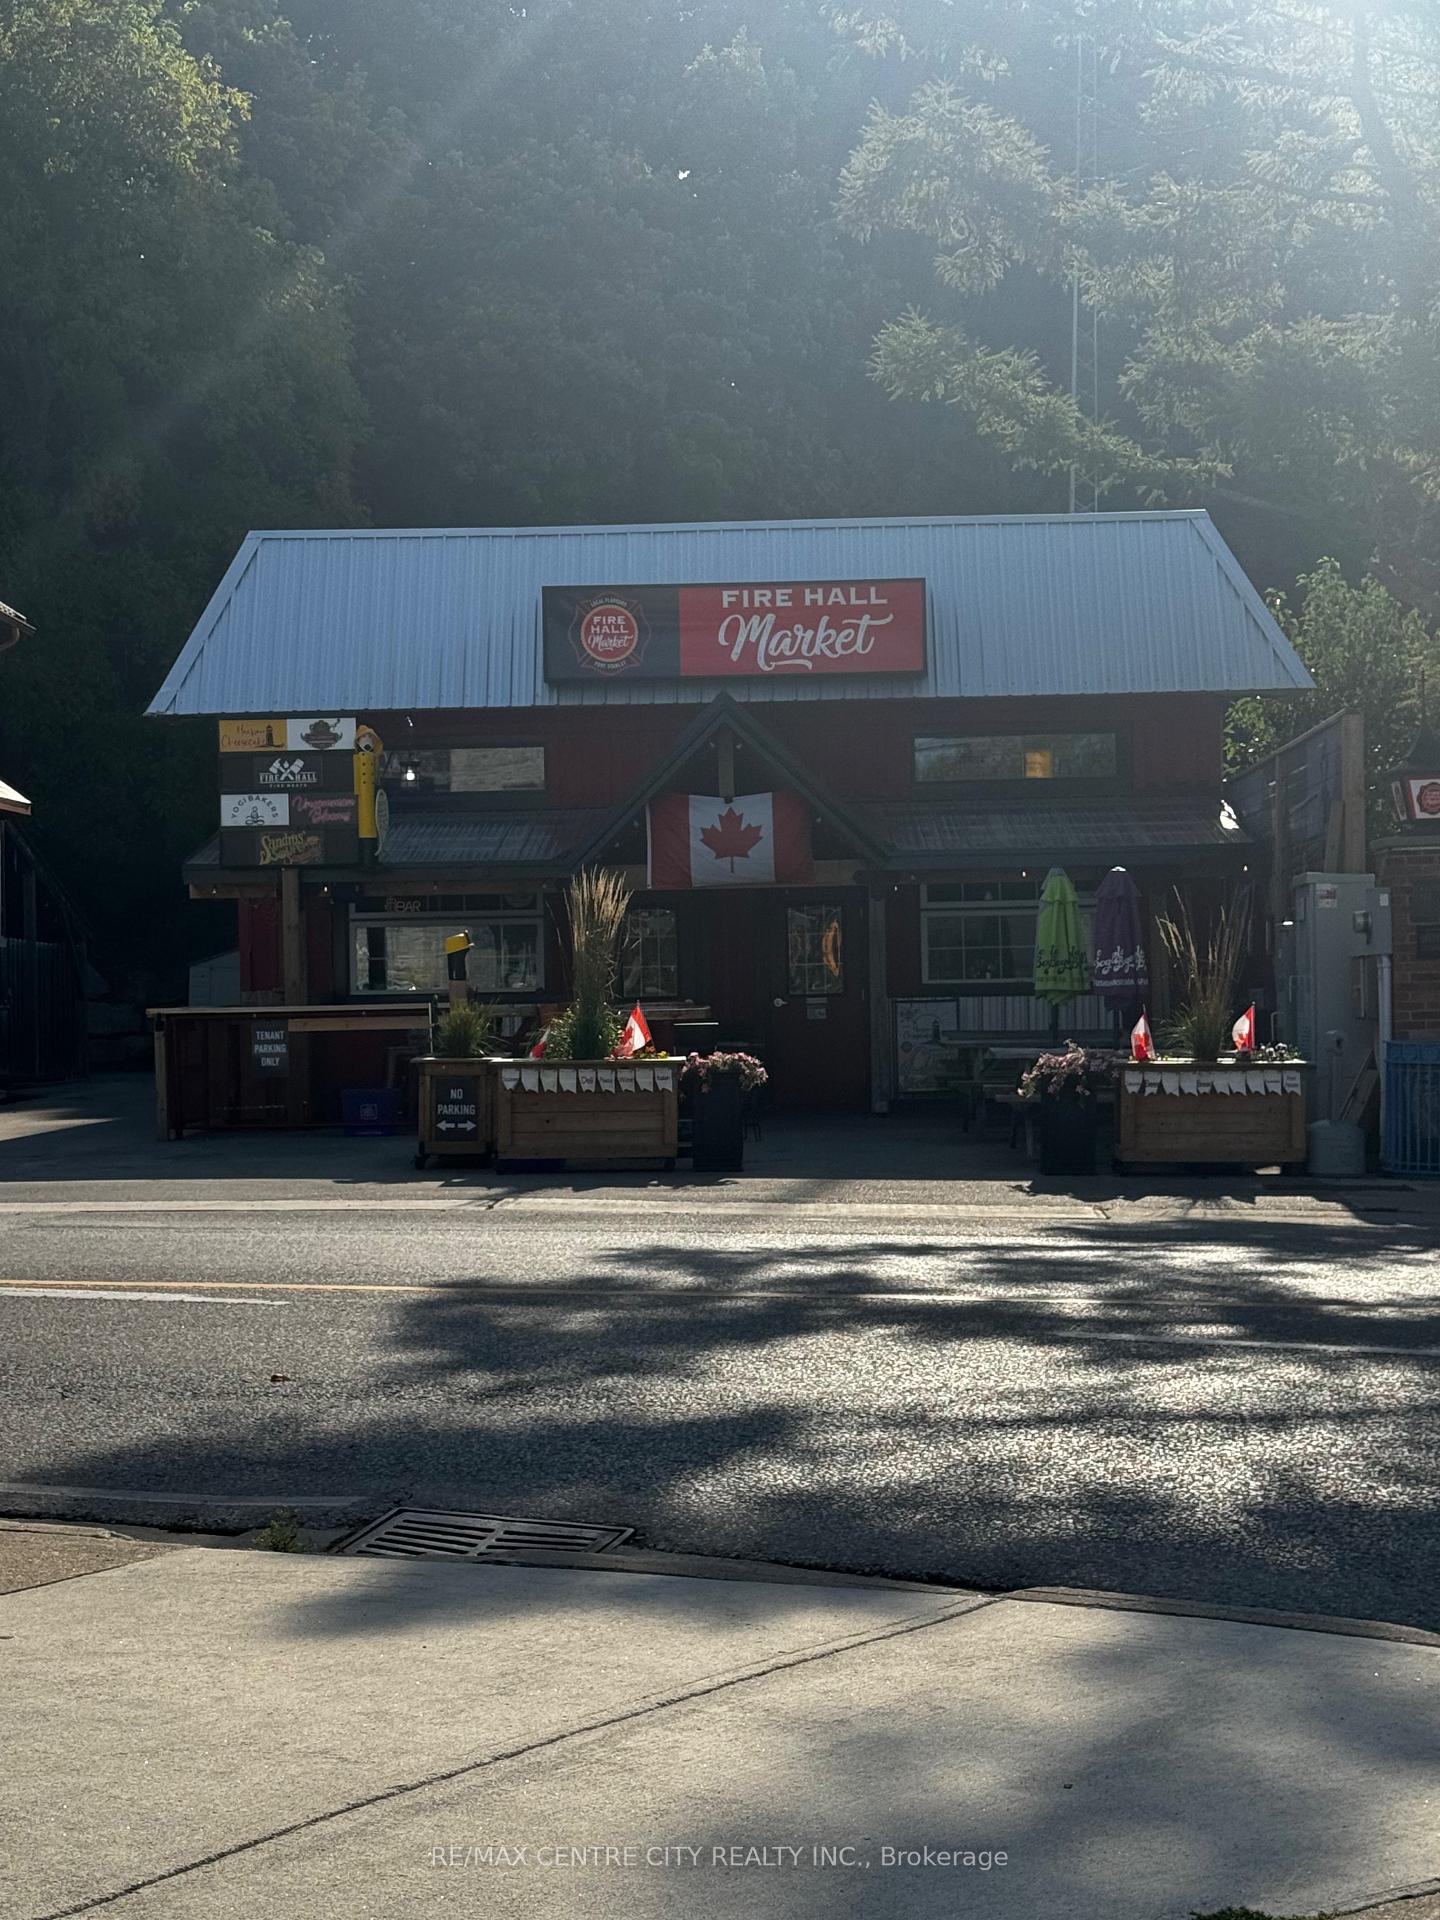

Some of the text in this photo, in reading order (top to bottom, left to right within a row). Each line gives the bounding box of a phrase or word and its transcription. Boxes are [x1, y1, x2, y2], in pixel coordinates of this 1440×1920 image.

[722, 587, 888, 608] FIRE HALL
[593, 616, 626, 625] FIRE
[591, 625, 629, 634] HALL
[588, 634, 633, 652] Market
[718, 613, 893, 672] Market
[259, 773, 317, 782] FIRE HALL
[256, 1031, 285, 1040] TENANT
[254, 1044, 287, 1054] PARKING
[261, 1057, 280, 1067] ONLY
[450, 1088, 463, 1100] NO
[437, 1104, 476, 1116] PARKING
